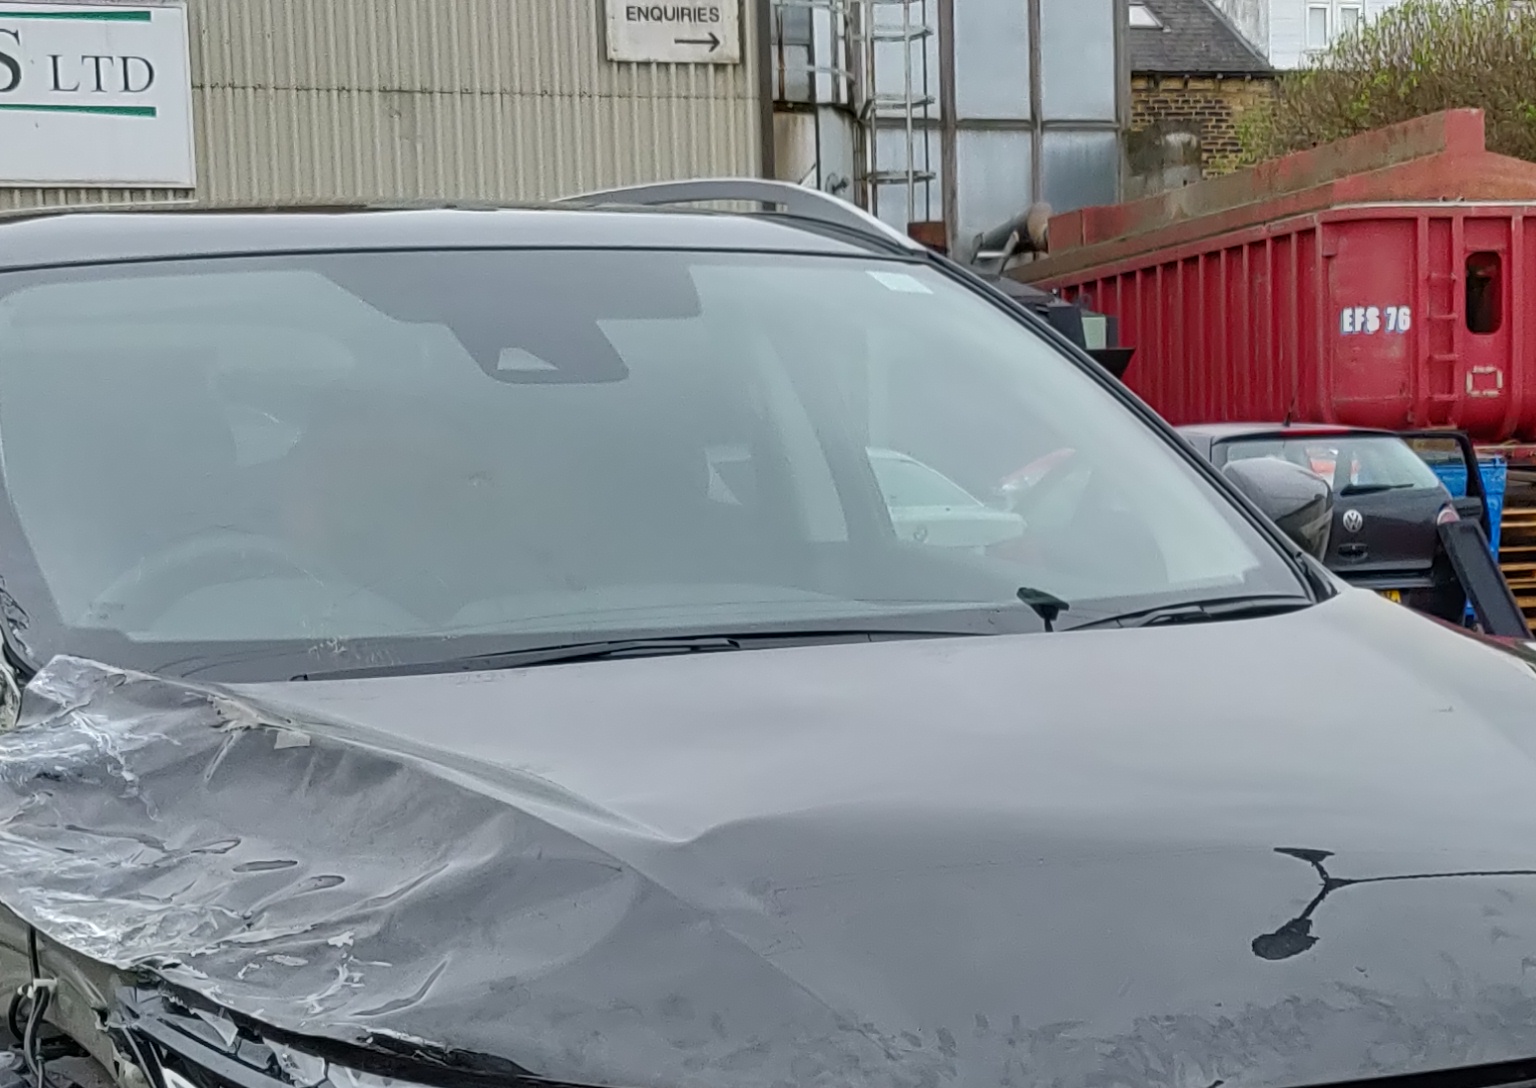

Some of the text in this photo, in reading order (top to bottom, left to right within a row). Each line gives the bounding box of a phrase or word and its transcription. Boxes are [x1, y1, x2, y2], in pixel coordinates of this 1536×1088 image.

[625, 5, 720, 23] ENQUIRIES
[47, 54, 156, 94] LTD
[1384, 304, 1412, 334] 76
